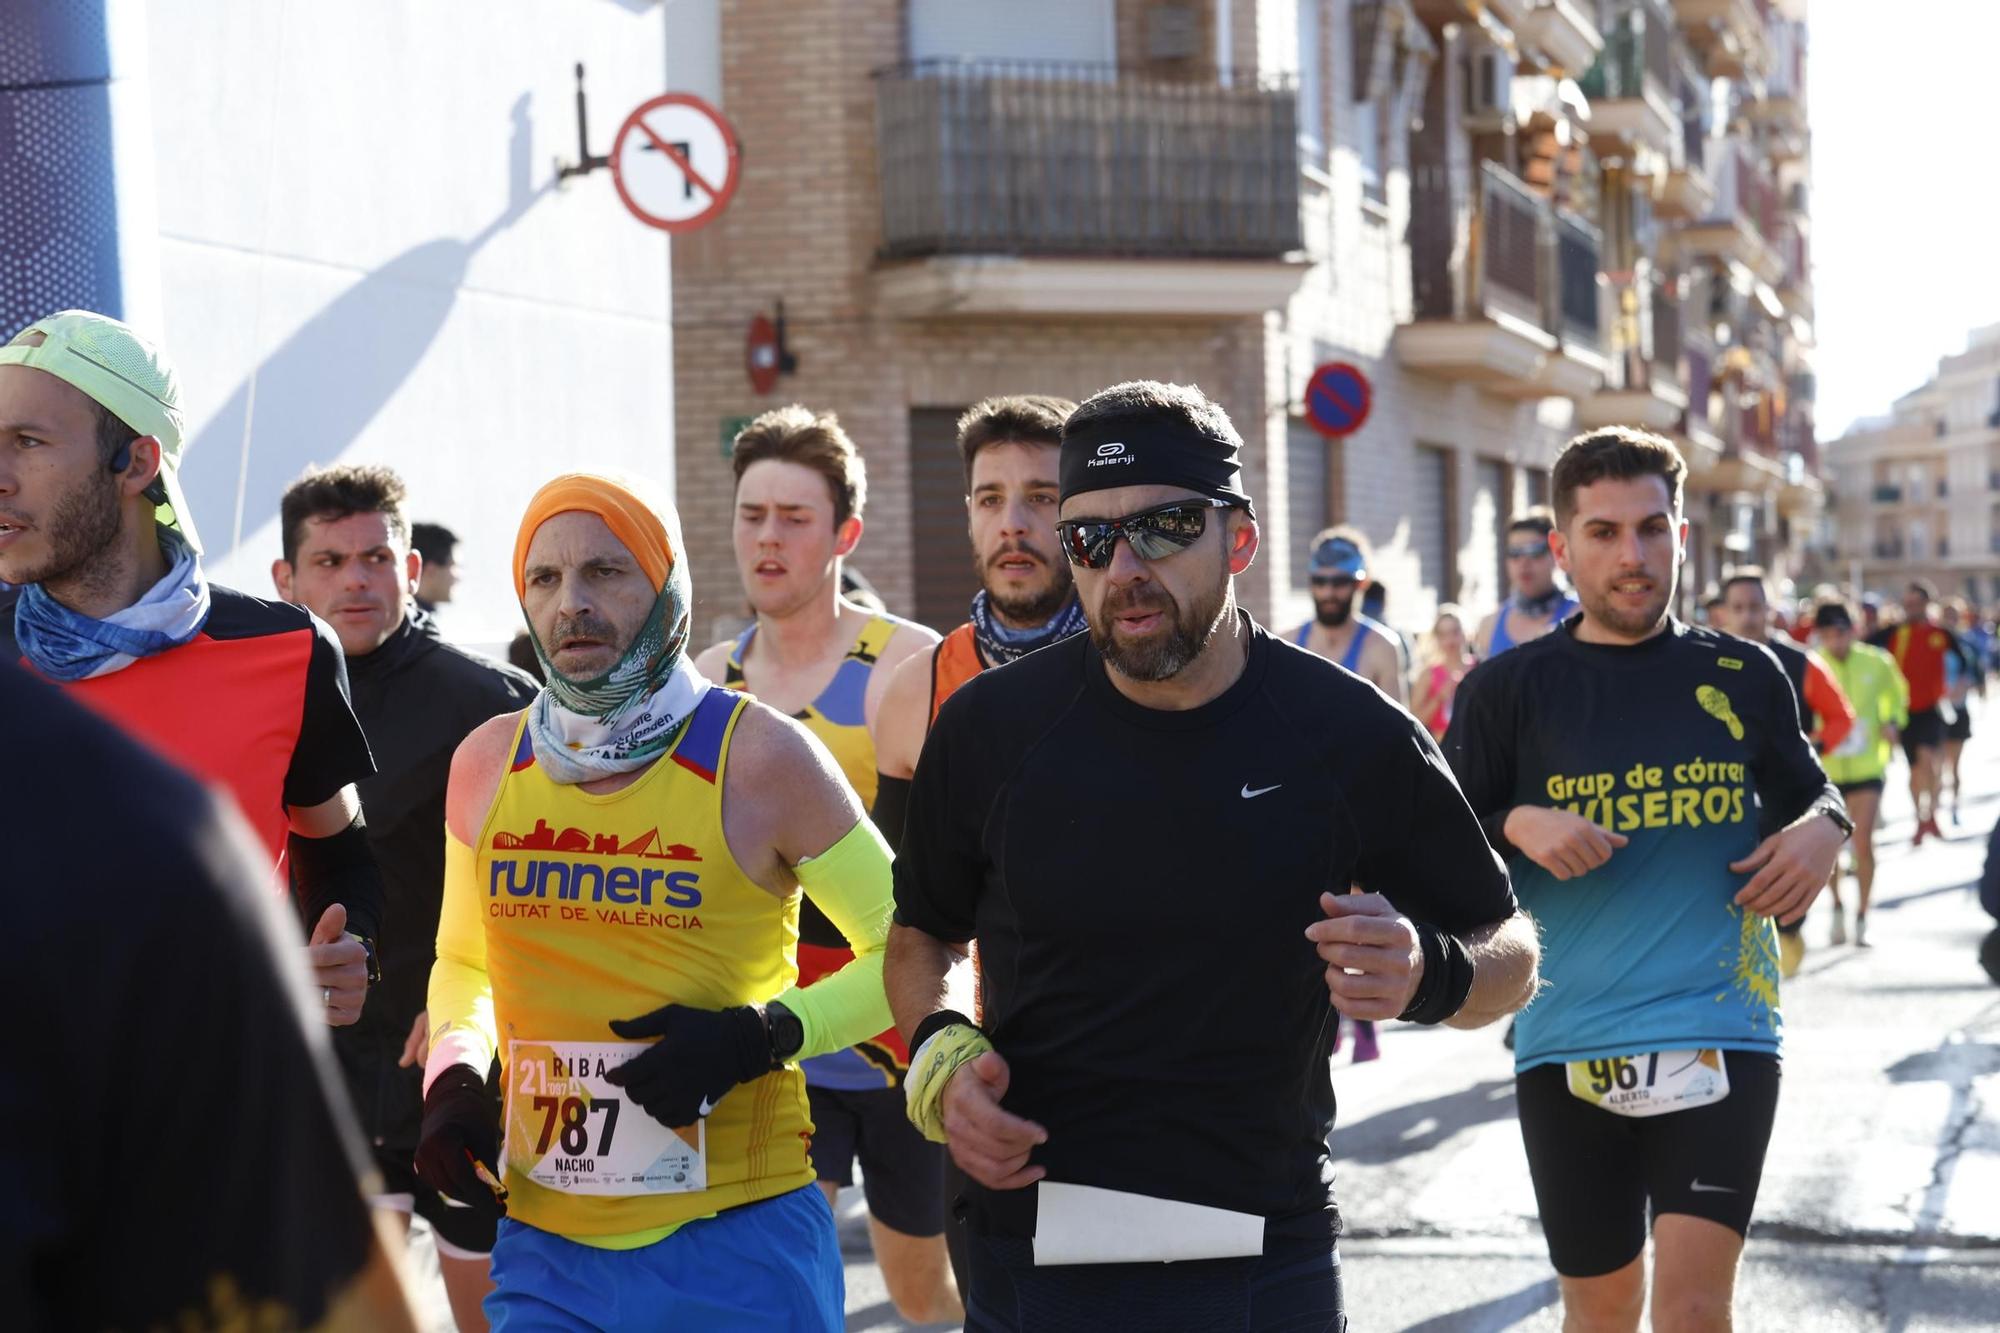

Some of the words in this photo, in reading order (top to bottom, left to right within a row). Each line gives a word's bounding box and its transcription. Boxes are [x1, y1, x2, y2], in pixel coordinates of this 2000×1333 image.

[1087, 454, 1135, 468] Kalenji
[1547, 771, 1615, 801] Grup
[1625, 762, 1663, 789] de
[1551, 786, 1745, 832] USEROS
[490, 859, 703, 909] runners
[490, 902, 552, 919] CIUTAT
[560, 906, 589, 921] DE
[596, 907, 703, 930] VALÈNCIA
[519, 1059, 547, 1095] 21
[1588, 1052, 1660, 1094] 967
[1609, 1090, 1650, 1105] ALBERTO
[533, 1097, 620, 1157] 787
[555, 1158, 595, 1173] NACHO
